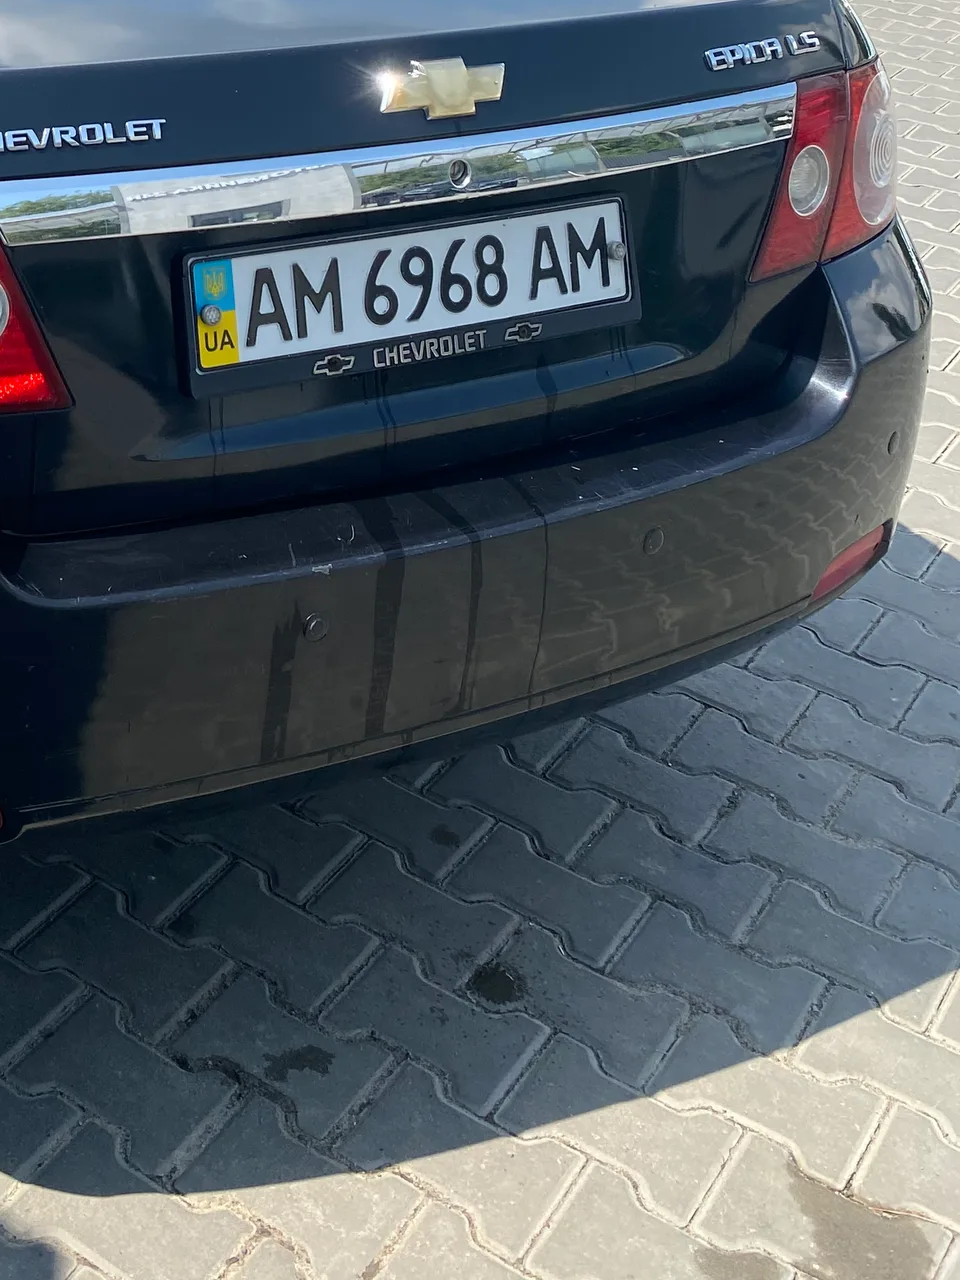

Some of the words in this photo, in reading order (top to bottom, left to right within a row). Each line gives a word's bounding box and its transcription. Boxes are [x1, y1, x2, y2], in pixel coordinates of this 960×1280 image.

[704, 37, 784, 71] EPICA
[785, 30, 821, 56] LS
[245, 257, 345, 348] AM
[363, 234, 509, 326] 6968
[528, 216, 612, 301] AM
[204, 329, 235, 352] UA
[373, 329, 487, 368] CHEVROLET
